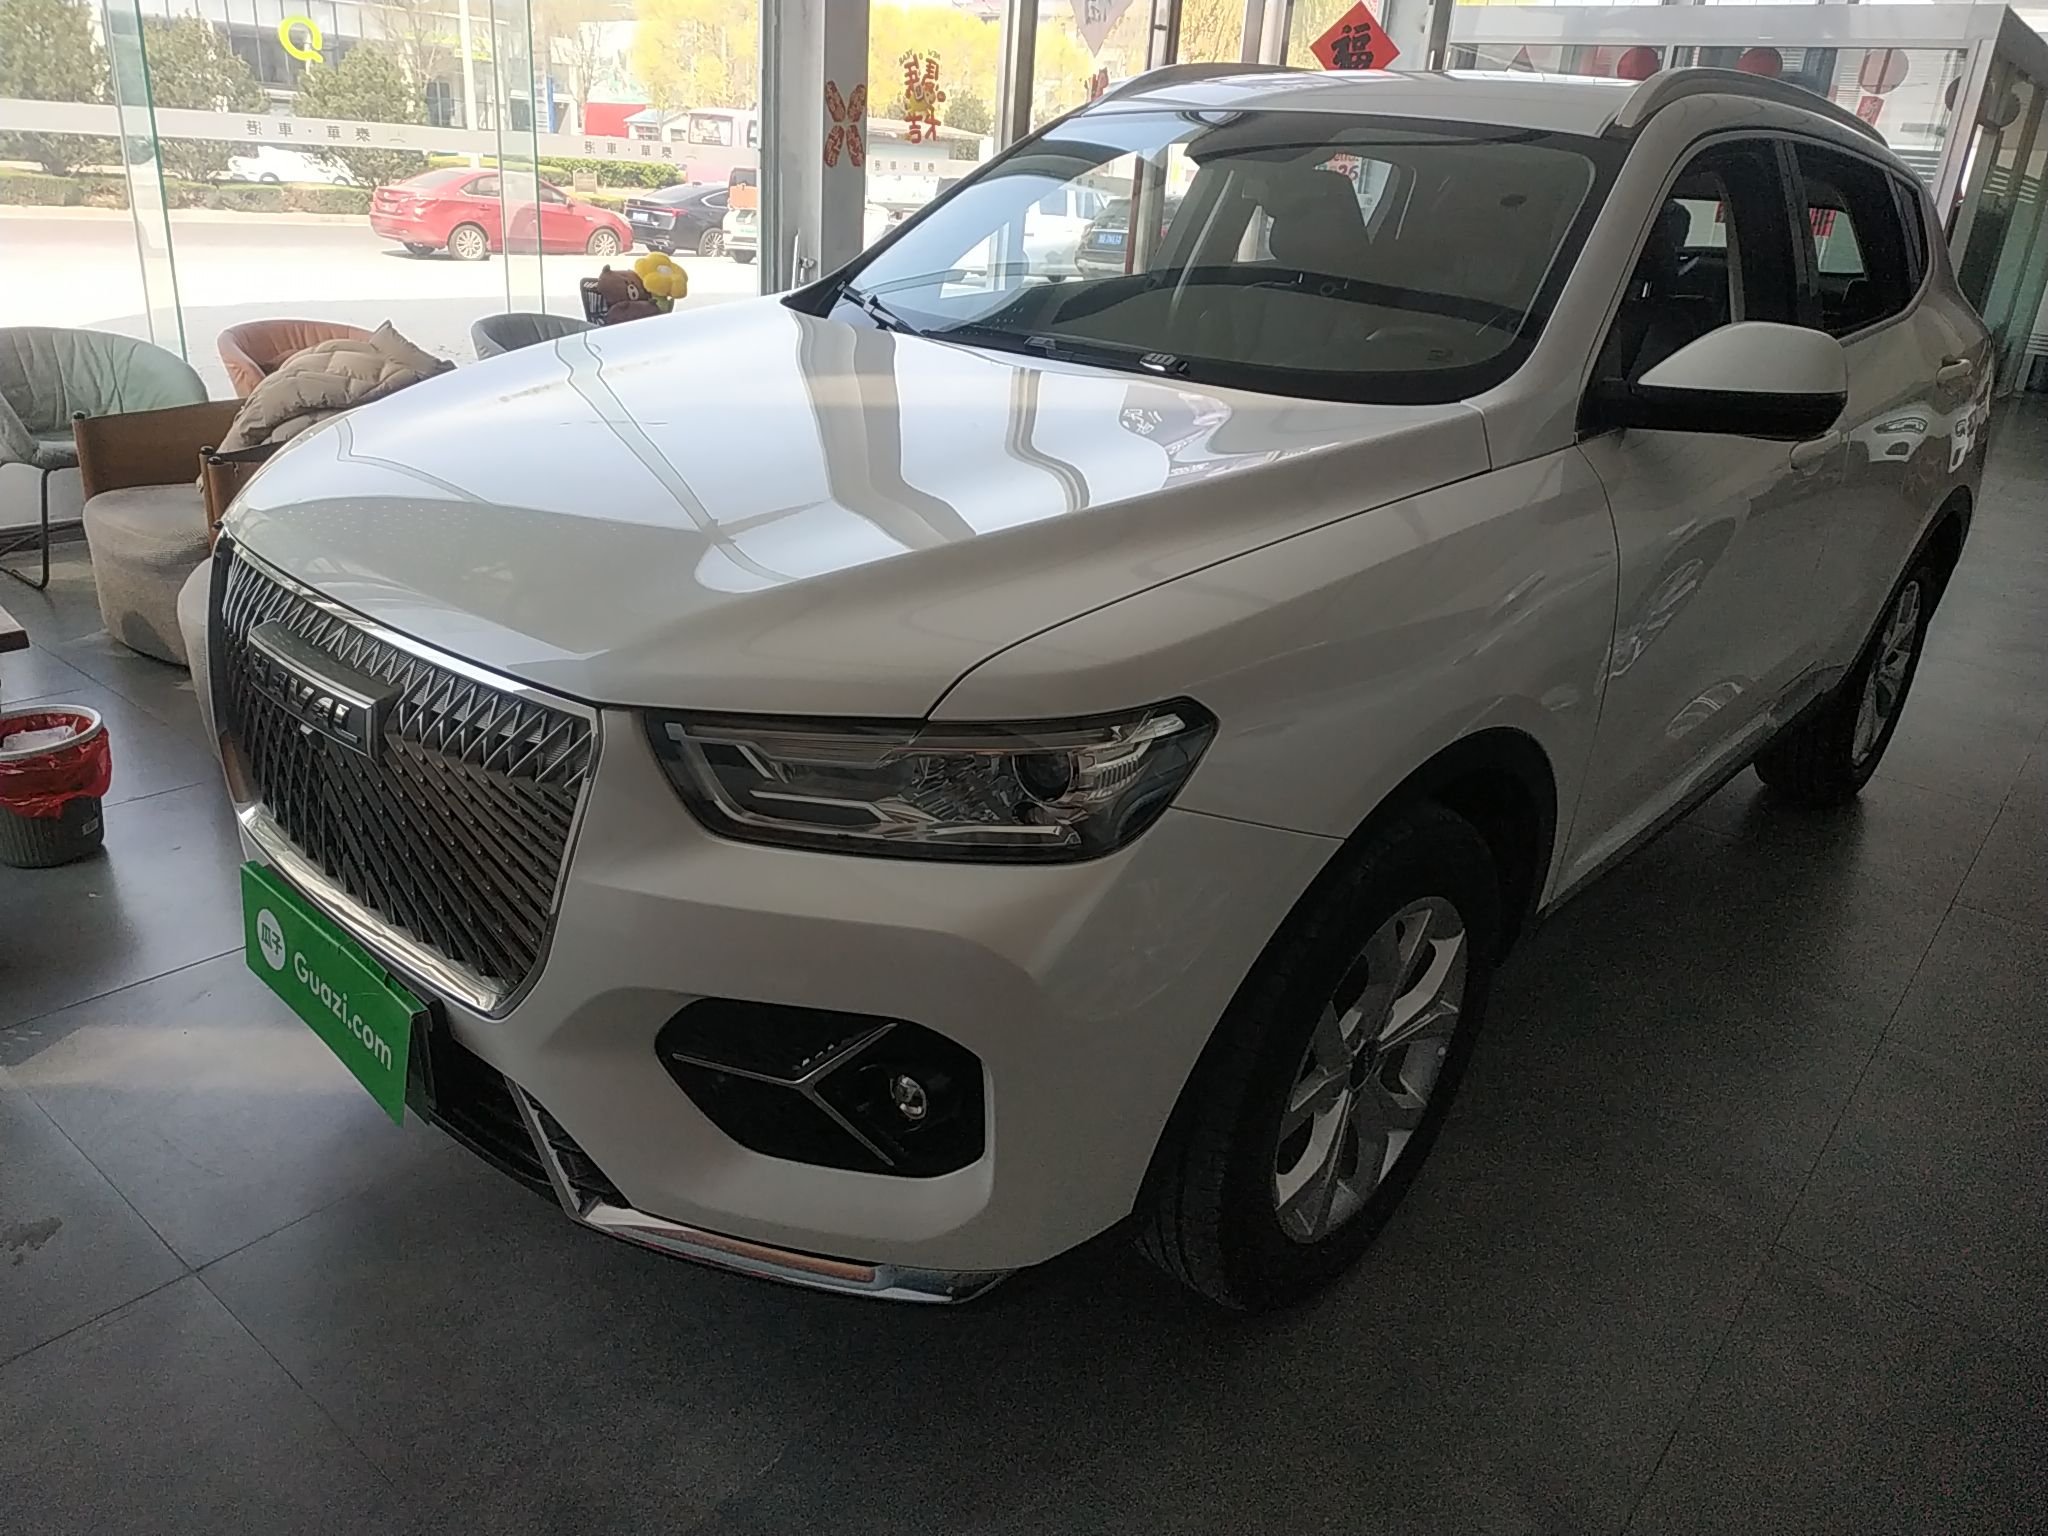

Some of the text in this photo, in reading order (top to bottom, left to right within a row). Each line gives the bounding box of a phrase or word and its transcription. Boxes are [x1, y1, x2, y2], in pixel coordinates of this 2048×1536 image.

[1331, 22, 1374, 70] 福
[261, 922, 283, 956] 瓜子
[294, 951, 392, 1071] Guazi.com
